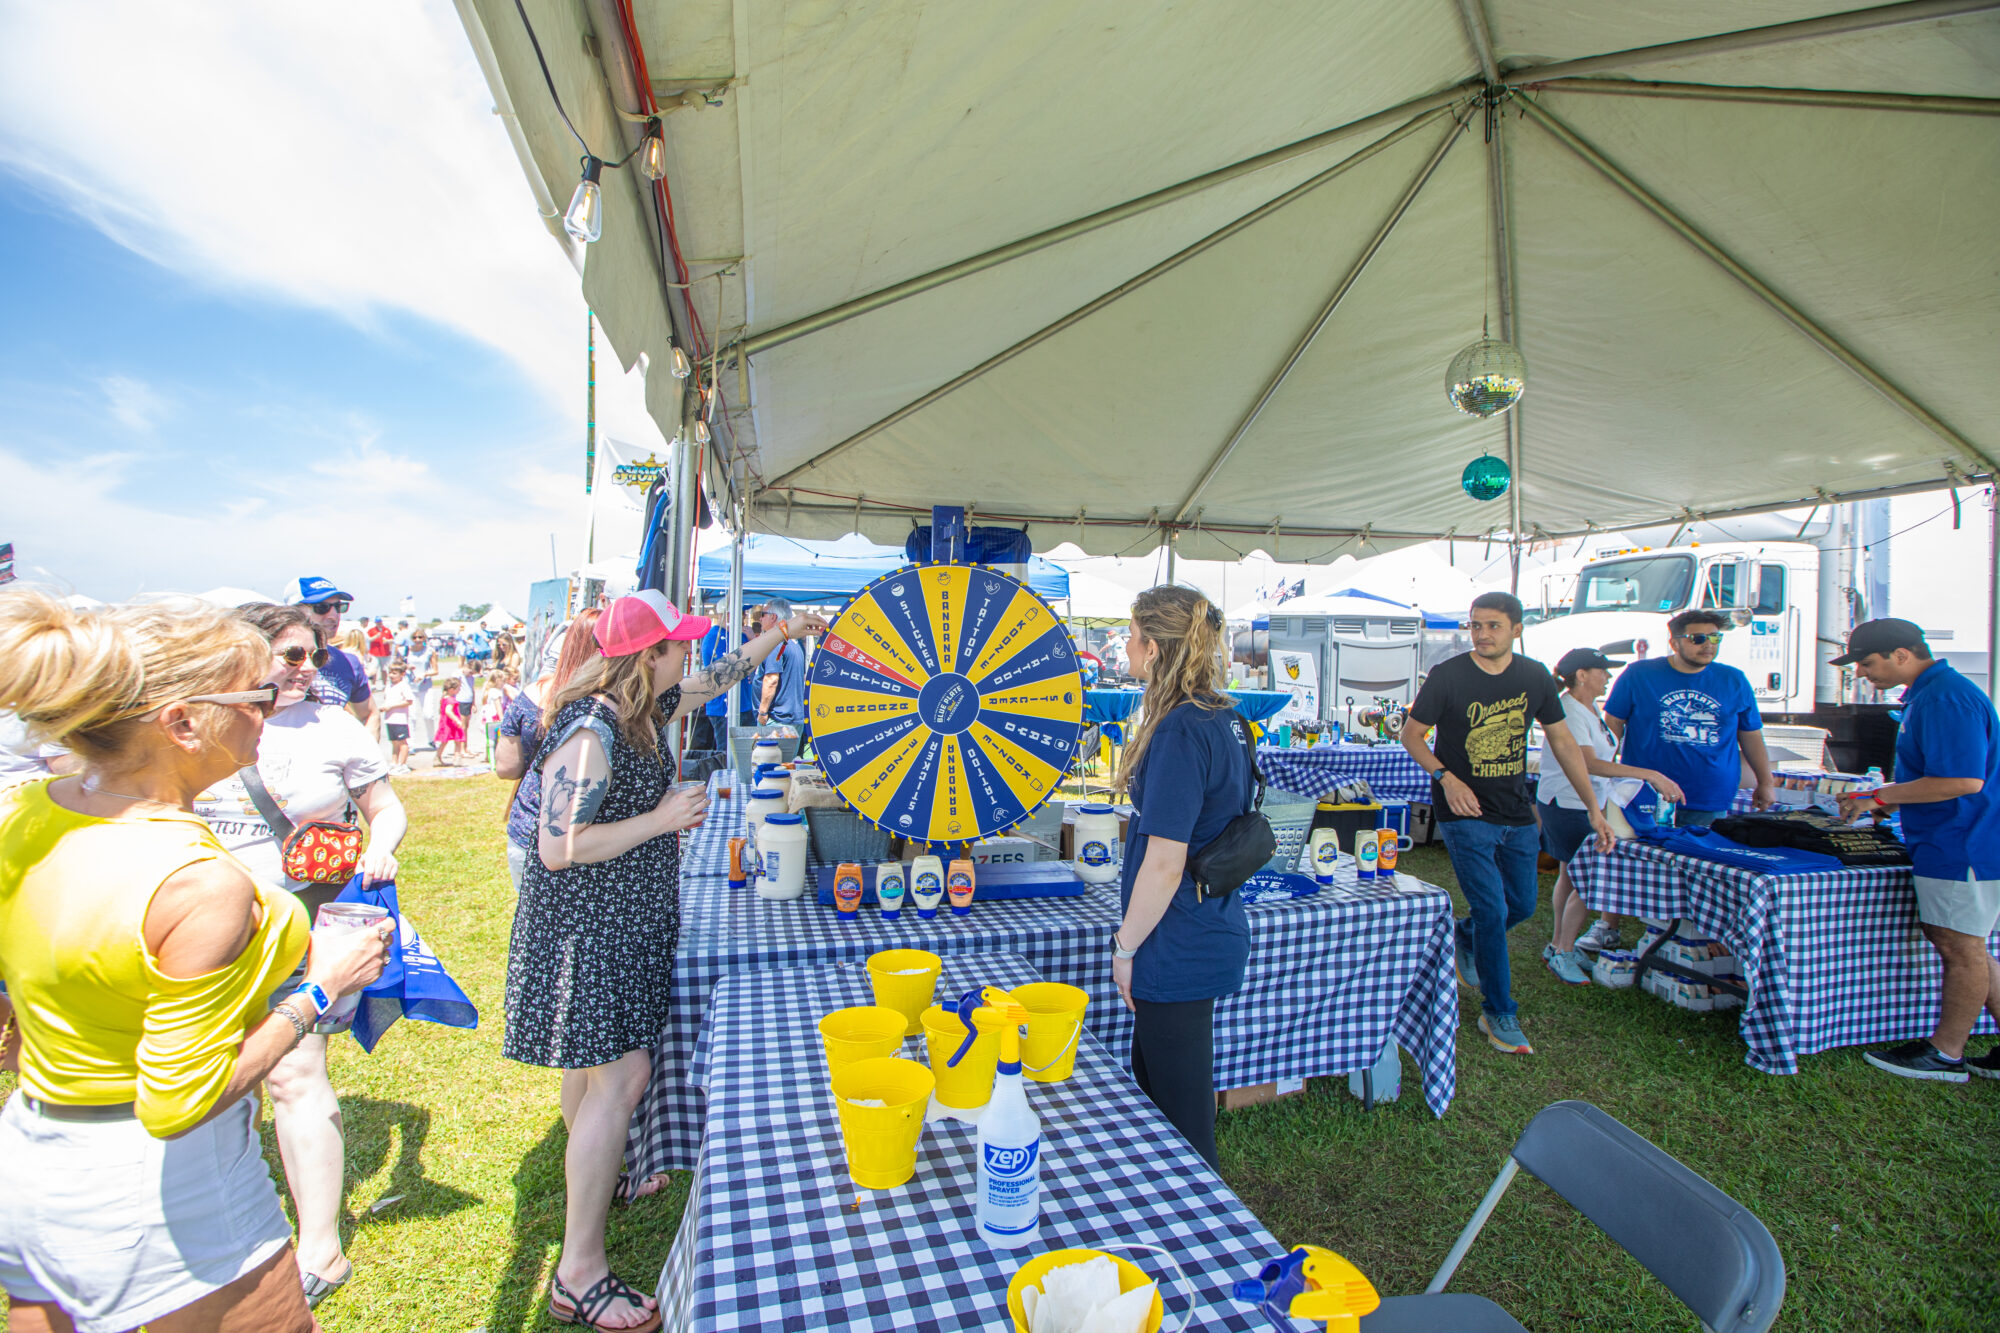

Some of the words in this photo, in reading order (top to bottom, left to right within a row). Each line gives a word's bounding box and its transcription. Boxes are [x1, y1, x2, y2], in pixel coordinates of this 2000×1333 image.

[900, 601, 934, 668] STICKER
[942, 591, 951, 663] BANDANA
[964, 599, 991, 657] TATTOO
[981, 619, 1026, 669] KOOZIE
[856, 654, 881, 670] WIN
[865, 625, 915, 673] KOOZIE
[840, 669, 901, 692] TATTOO
[994, 654, 1050, 685] TATTOO
[835, 703, 909, 713] BANDANA
[937, 704, 947, 723] BLUE
[944, 685, 963, 704] PLATE
[988, 695, 1059, 705] STICKER
[1467, 691, 1528, 728] Dressed
[1663, 693, 1686, 706] BLUE
[1687, 693, 1719, 709] PLATE
[846, 719, 914, 755] STICKER
[1005, 722, 1052, 744] MAYO
[872, 738, 918, 790] KOOZIE
[983, 734, 1032, 780] KOOZIE
[908, 741, 938, 811] STICKER
[947, 745, 956, 816] BANDANA
[967, 749, 997, 806] TATTOO
[988, 1176, 1035, 1188] PROFESSIONAL
[988, 1184, 1020, 1193] SPRAYER
